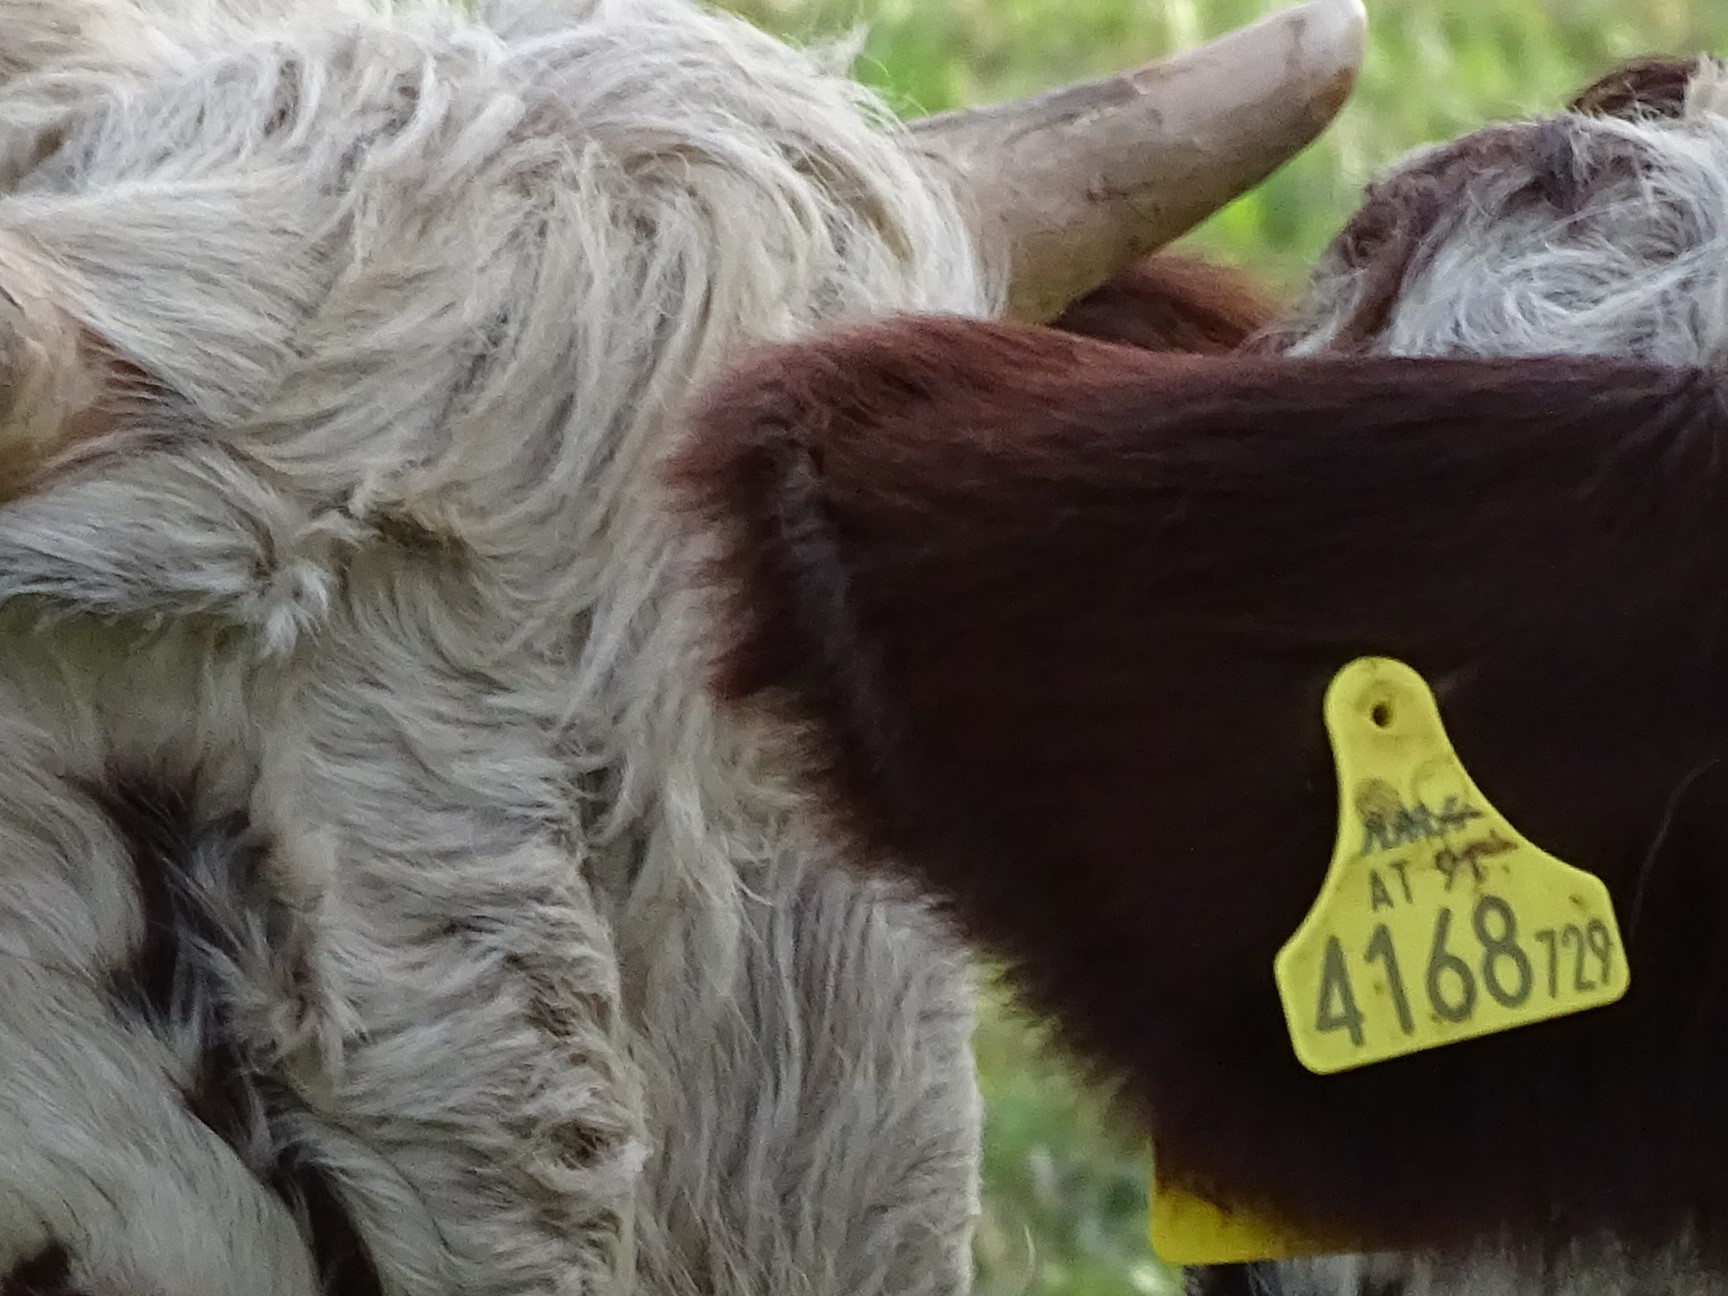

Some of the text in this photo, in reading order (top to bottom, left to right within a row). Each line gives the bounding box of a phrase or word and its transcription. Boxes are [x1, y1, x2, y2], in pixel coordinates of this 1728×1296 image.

[1368, 860, 1414, 913] AT
[1316, 895, 1614, 1046] 4168 729
